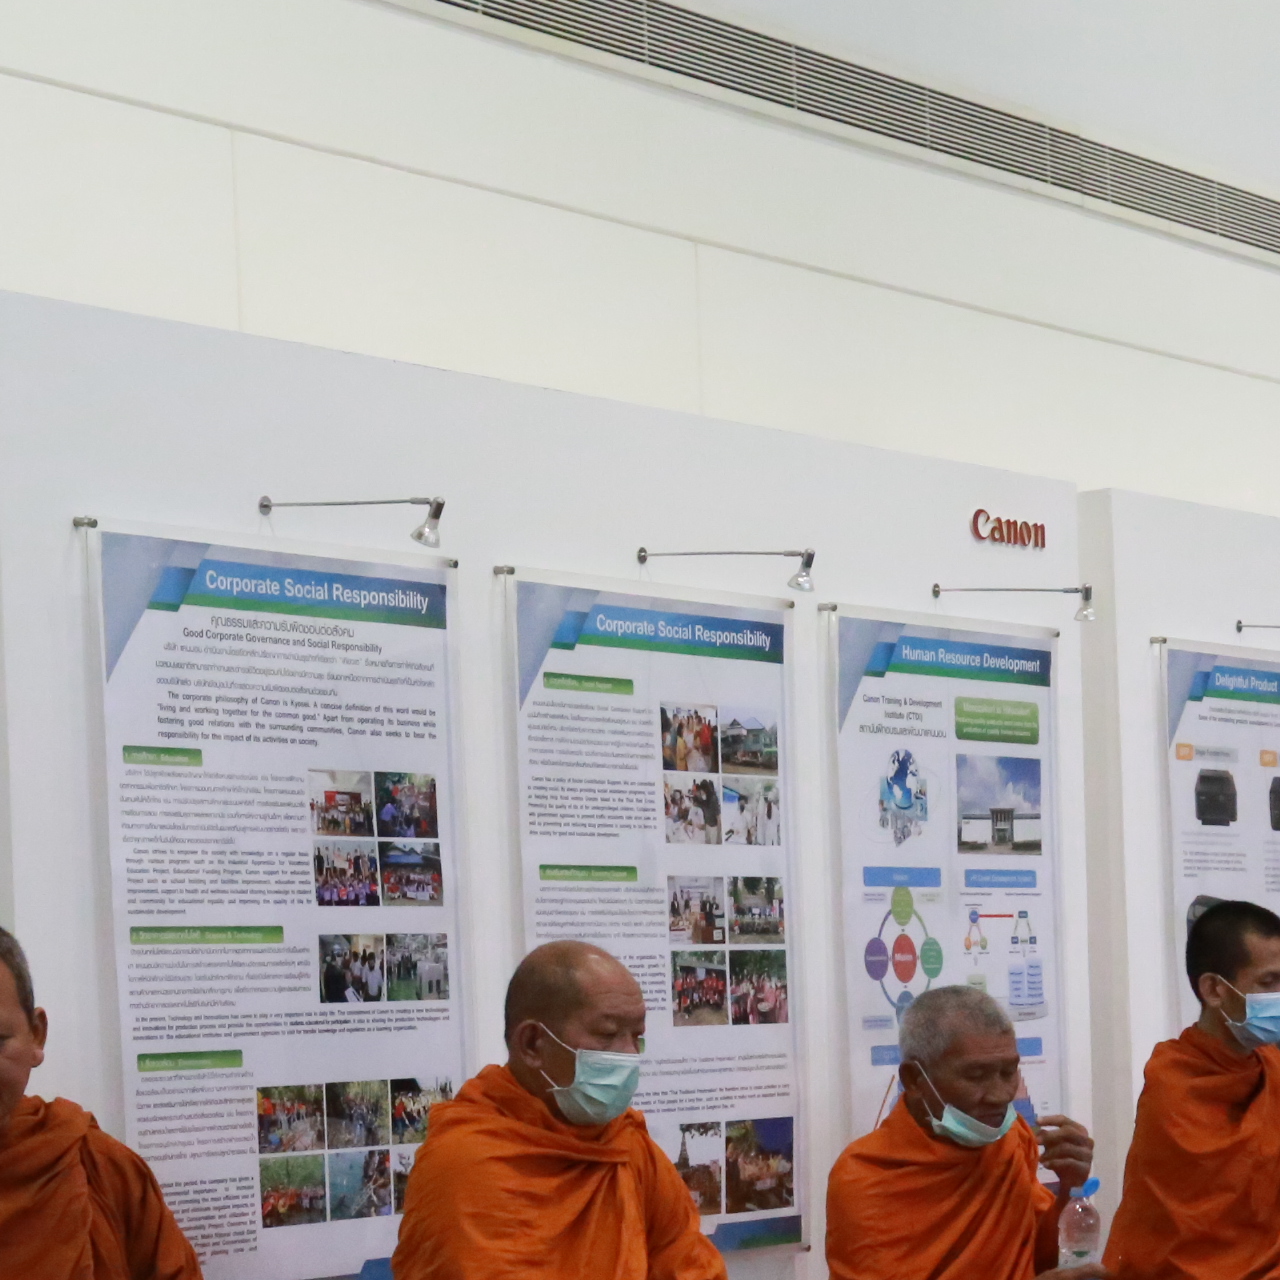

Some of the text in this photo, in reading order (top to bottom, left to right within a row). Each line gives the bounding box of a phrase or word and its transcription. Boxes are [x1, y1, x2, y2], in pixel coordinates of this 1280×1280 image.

[971, 509, 1045, 548] Canon
[206, 570, 428, 614] Corporate Social Responsibility
[183, 628, 382, 655] Good Corporate Governance and Social Responsibility
[596, 614, 770, 650] Corporate Social Responsibility
[902, 645, 1039, 673] Human Resource Development
[1216, 673, 1277, 692] Delightful Product
[168, 691, 179, 699] The
[183, 693, 212, 701] corporate
[216, 695, 248, 704] philosophy
[252, 696, 257, 704] of
[291, 700, 310, 708] Kyosei.
[345, 704, 371, 712] definition
[375, 704, 380, 712] of
[396, 706, 409, 714] word
[412, 707, 426, 715] would
[429, 708, 435, 716] be
[863, 694, 880, 703] Canon
[881, 696, 901, 707] Training
[909, 698, 942, 709] Development
